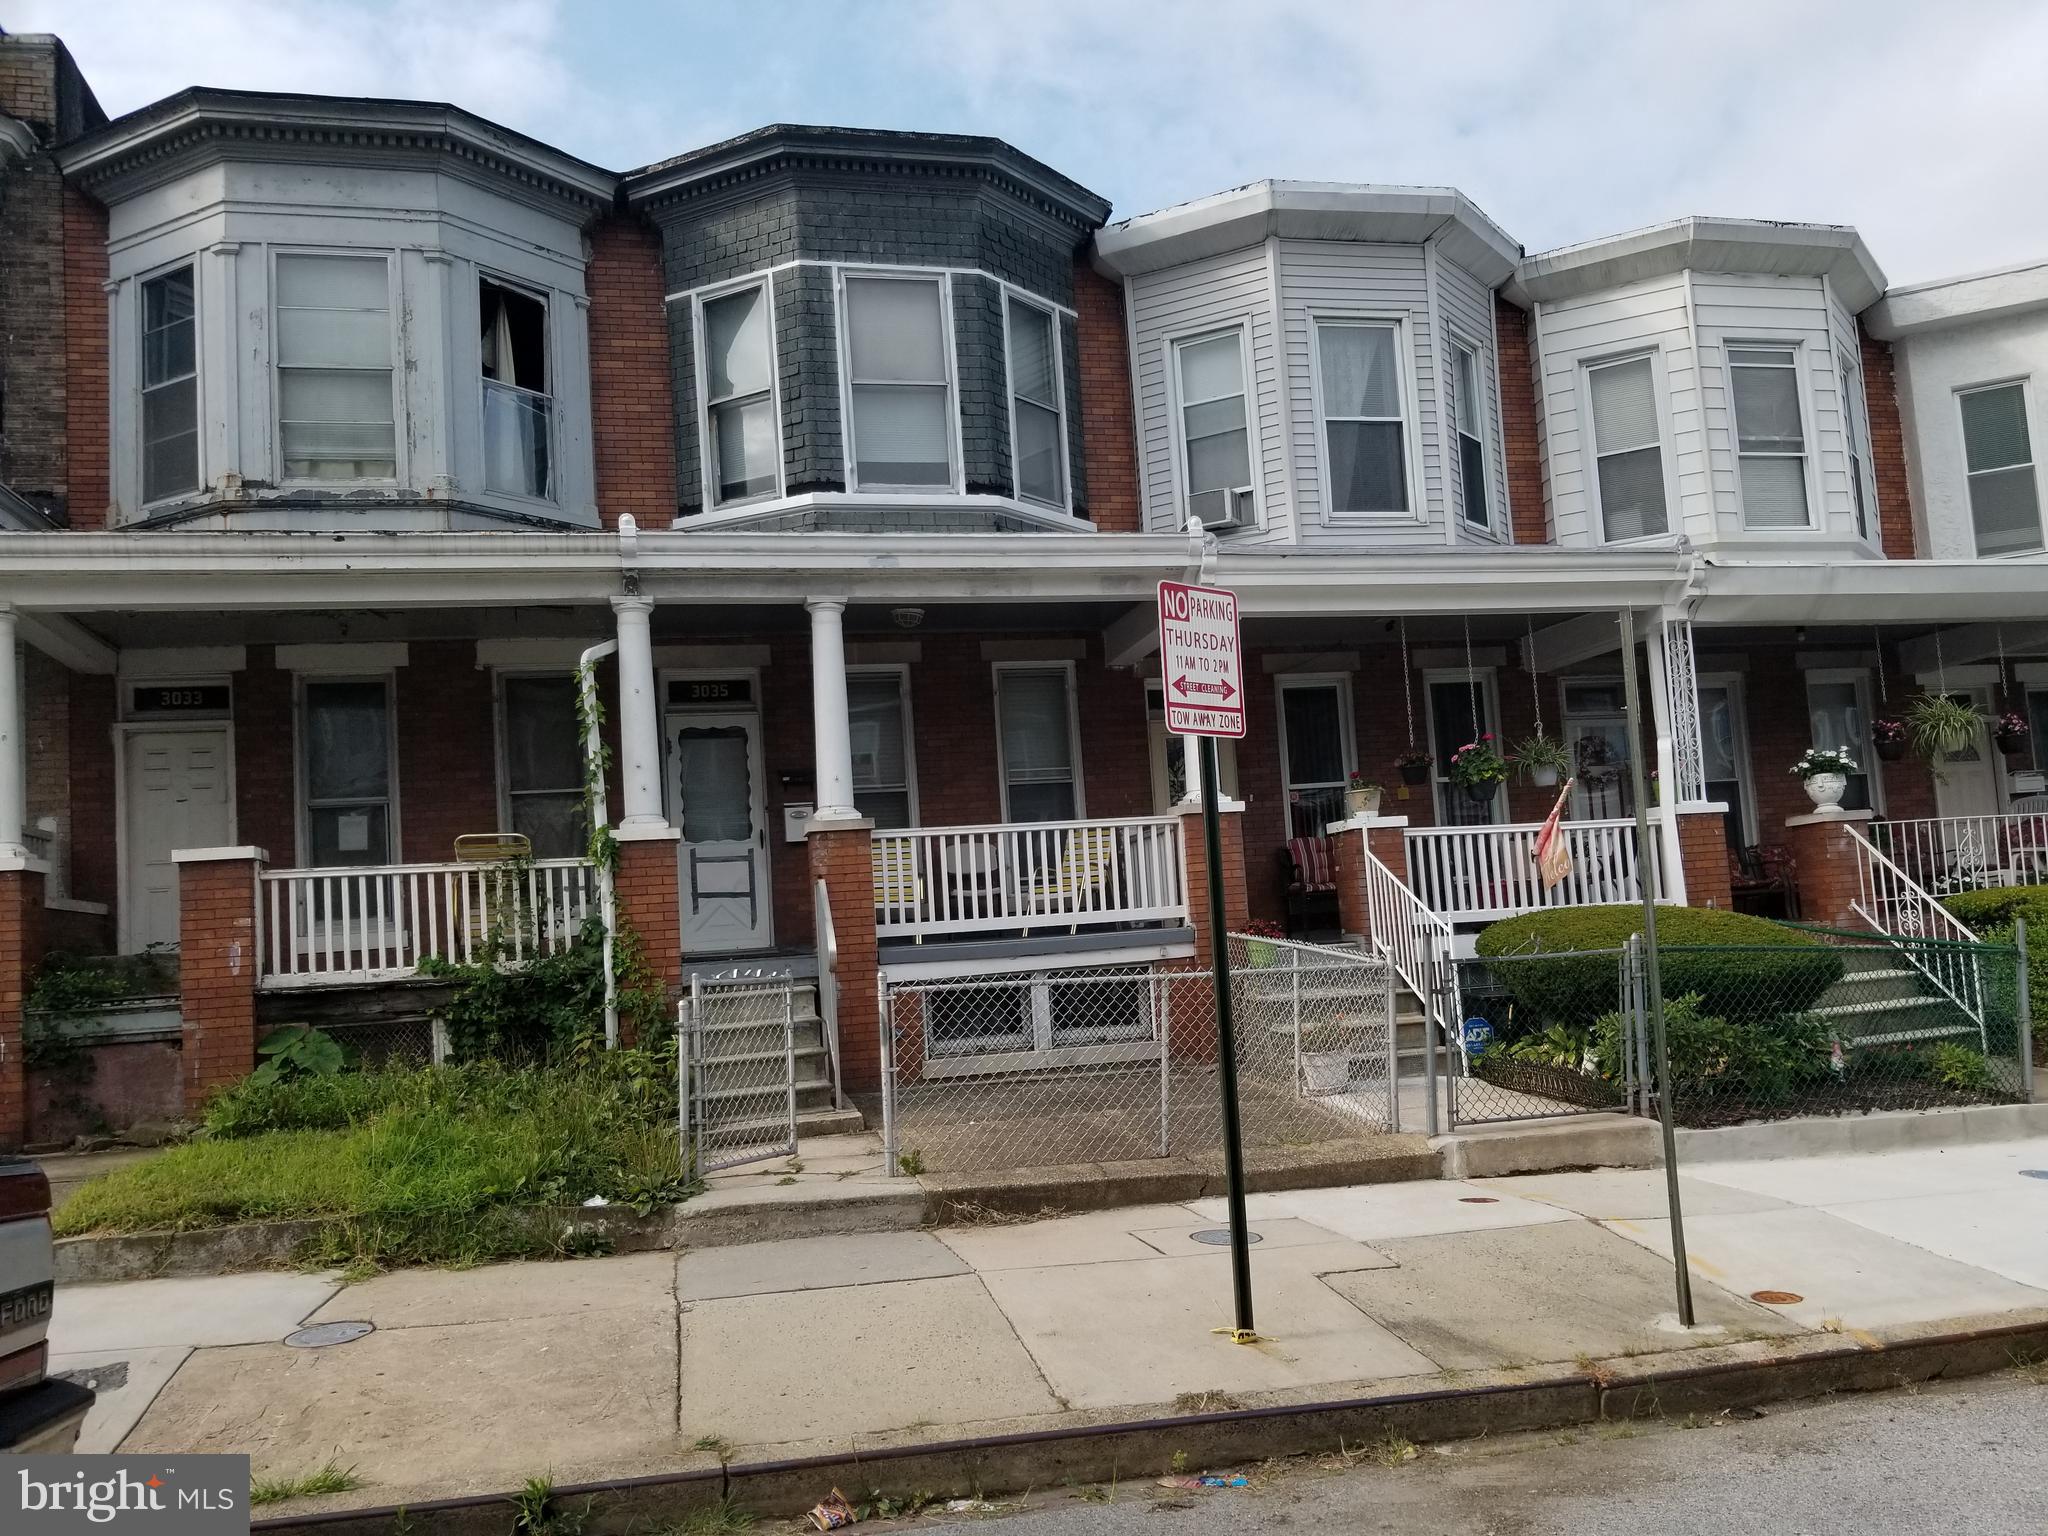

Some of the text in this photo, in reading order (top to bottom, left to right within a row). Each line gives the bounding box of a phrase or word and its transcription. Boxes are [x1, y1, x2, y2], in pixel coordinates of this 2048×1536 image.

[1164, 589, 1233, 622] NO PARKING
[1166, 628, 1234, 653] THURSDAY
[1198, 657, 1210, 672] TO
[691, 684, 729, 698] 3035
[1180, 681, 1228, 694] STREET CLEANING
[161, 691, 202, 705] 3033
[1171, 710, 1241, 730] TOW AWAY ZONE
[1, 1292, 49, 1327] FORD
